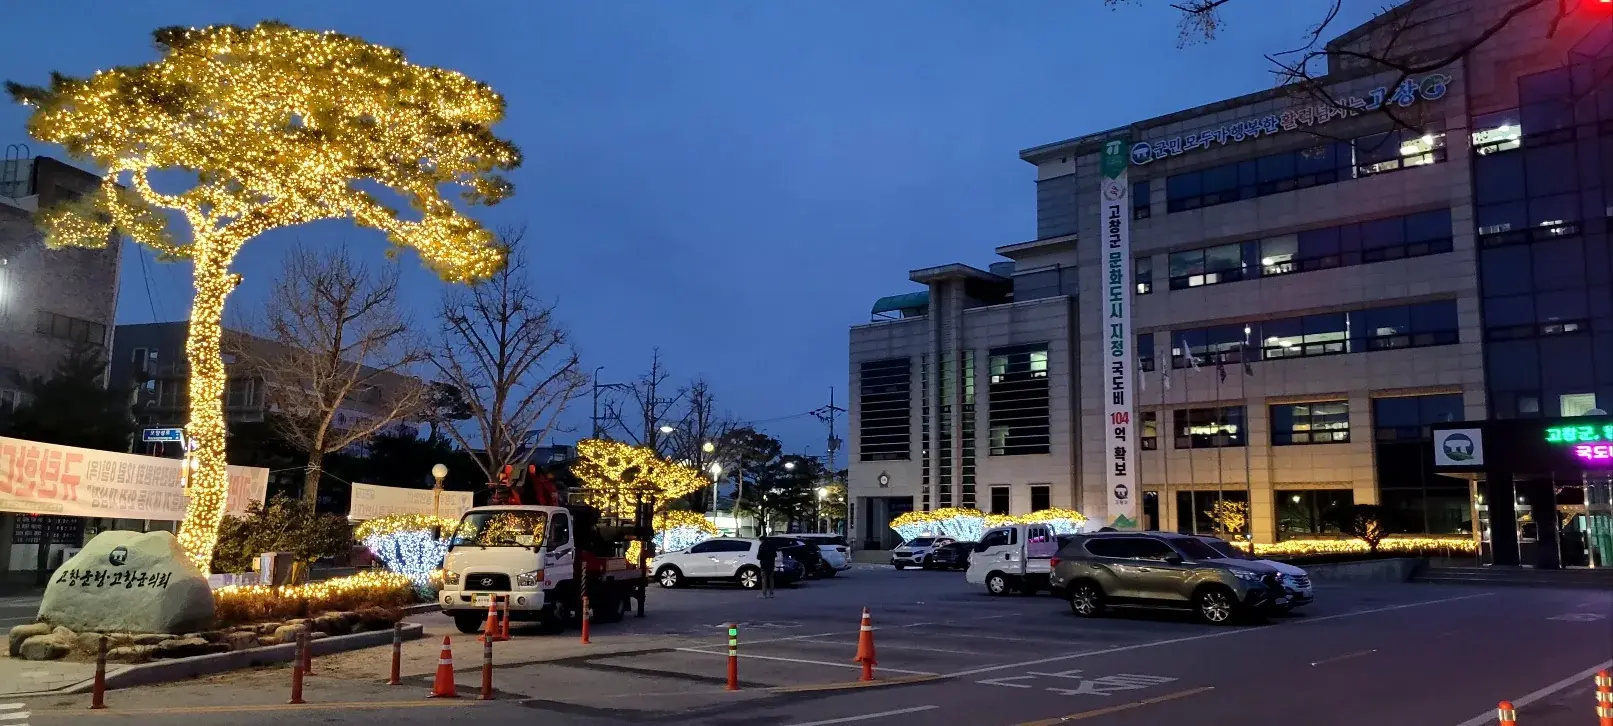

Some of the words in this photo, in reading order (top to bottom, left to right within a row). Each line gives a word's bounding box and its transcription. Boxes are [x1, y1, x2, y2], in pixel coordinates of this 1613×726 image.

[1152, 136, 1183, 159] 군민
[1183, 127, 1228, 151] 모두가
[1229, 114, 1279, 142] 행복한
[1365, 78, 1416, 110] 고창
[1109, 205, 1121, 249] 고창군
[1109, 252, 1123, 318] 문화도시
[1110, 323, 1123, 357] 지정
[1112, 361, 1125, 406] 국도비
[1114, 446, 1127, 477] 확보
